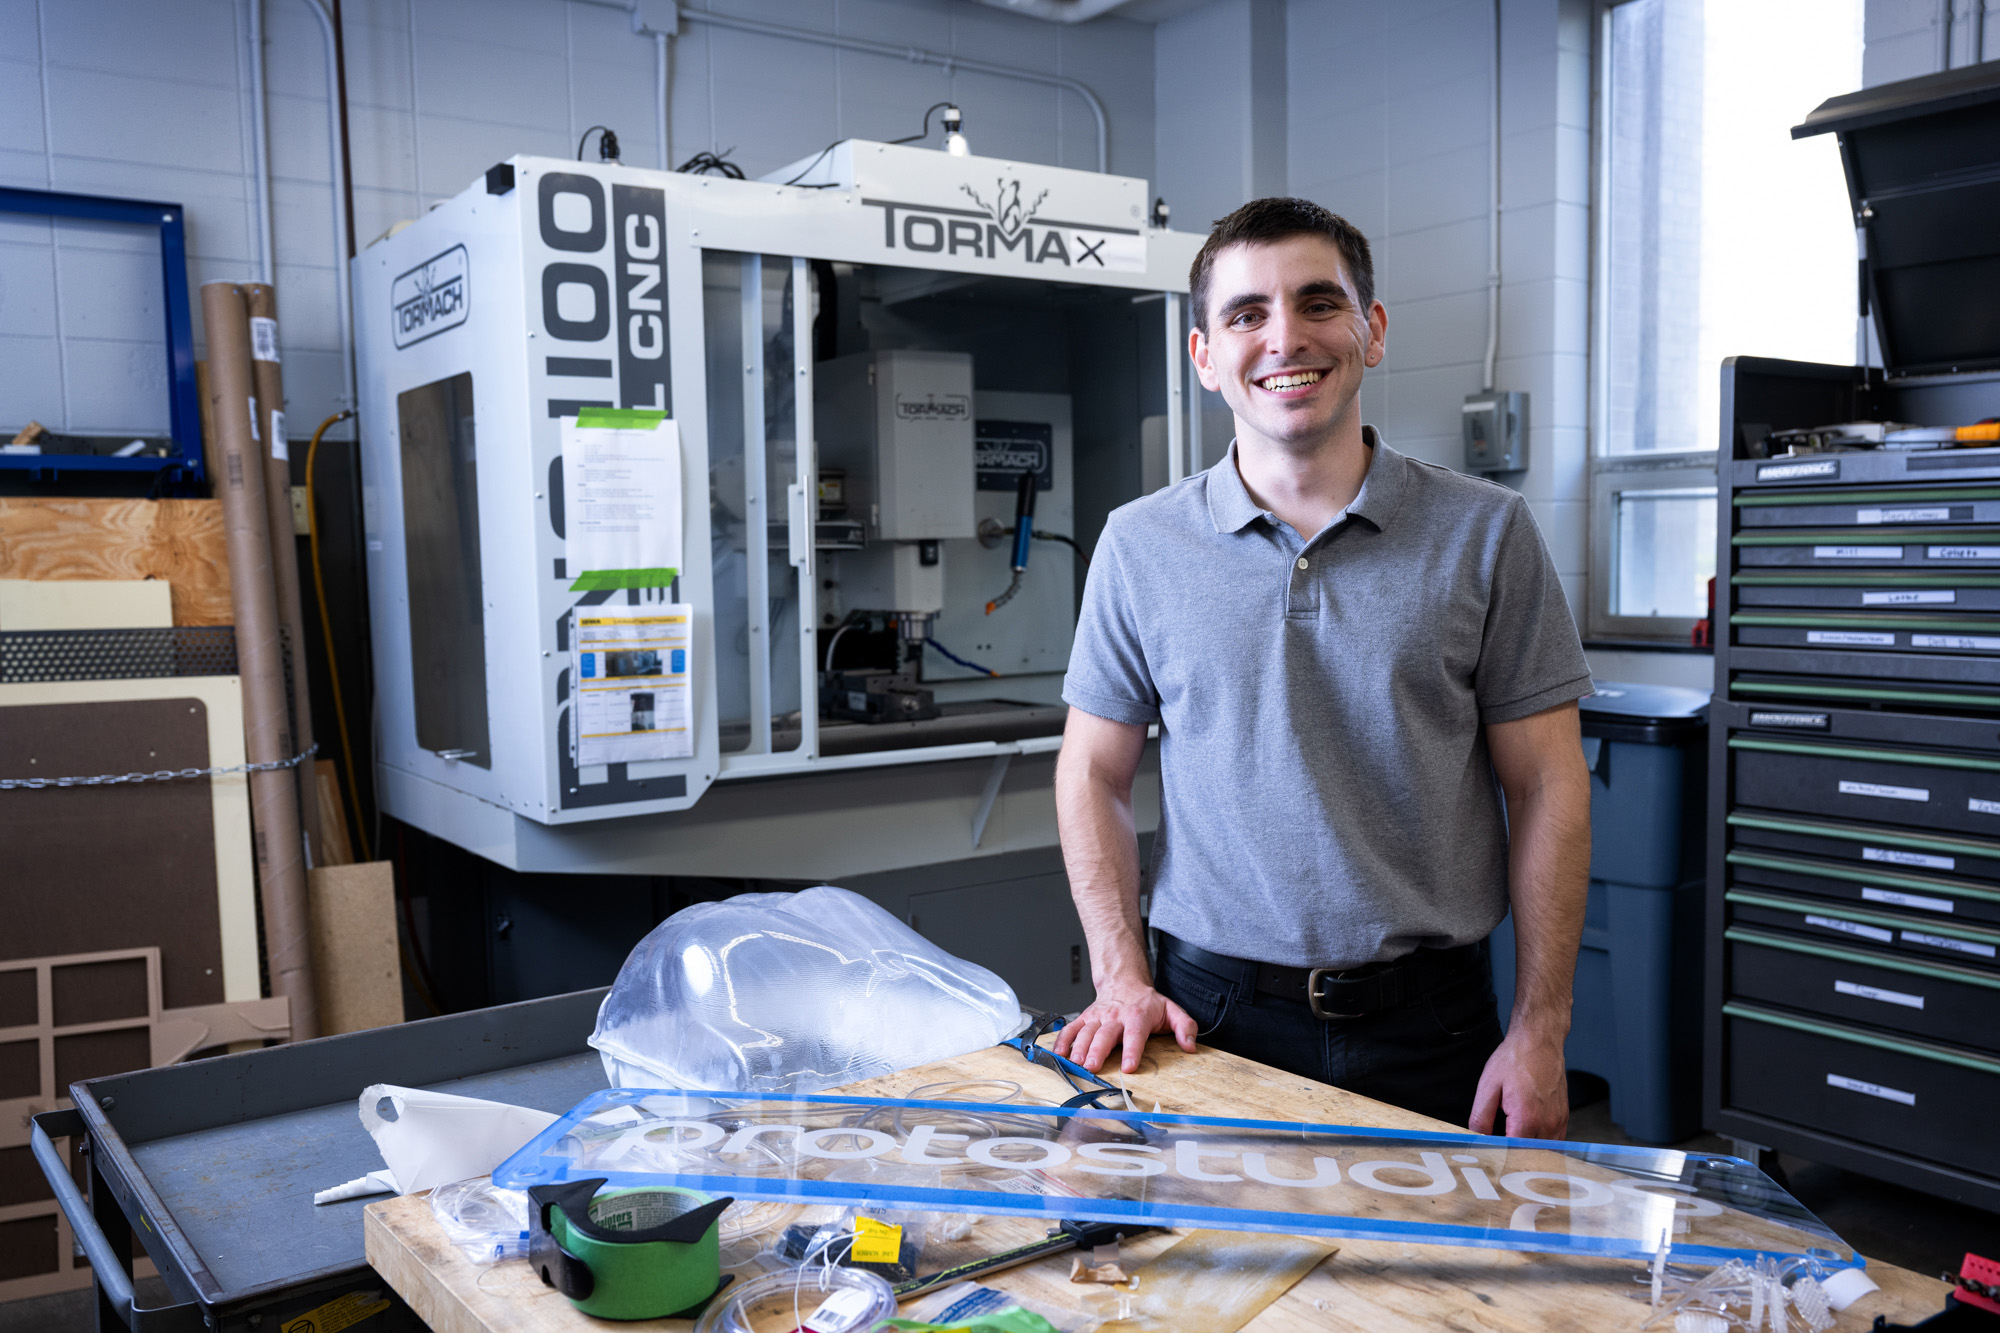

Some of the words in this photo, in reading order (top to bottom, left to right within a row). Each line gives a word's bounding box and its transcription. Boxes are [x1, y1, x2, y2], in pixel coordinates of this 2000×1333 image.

[862, 198, 1105, 267] TORMAX
[395, 275, 463, 333] TORMACH
[624, 213, 664, 360] CNC
